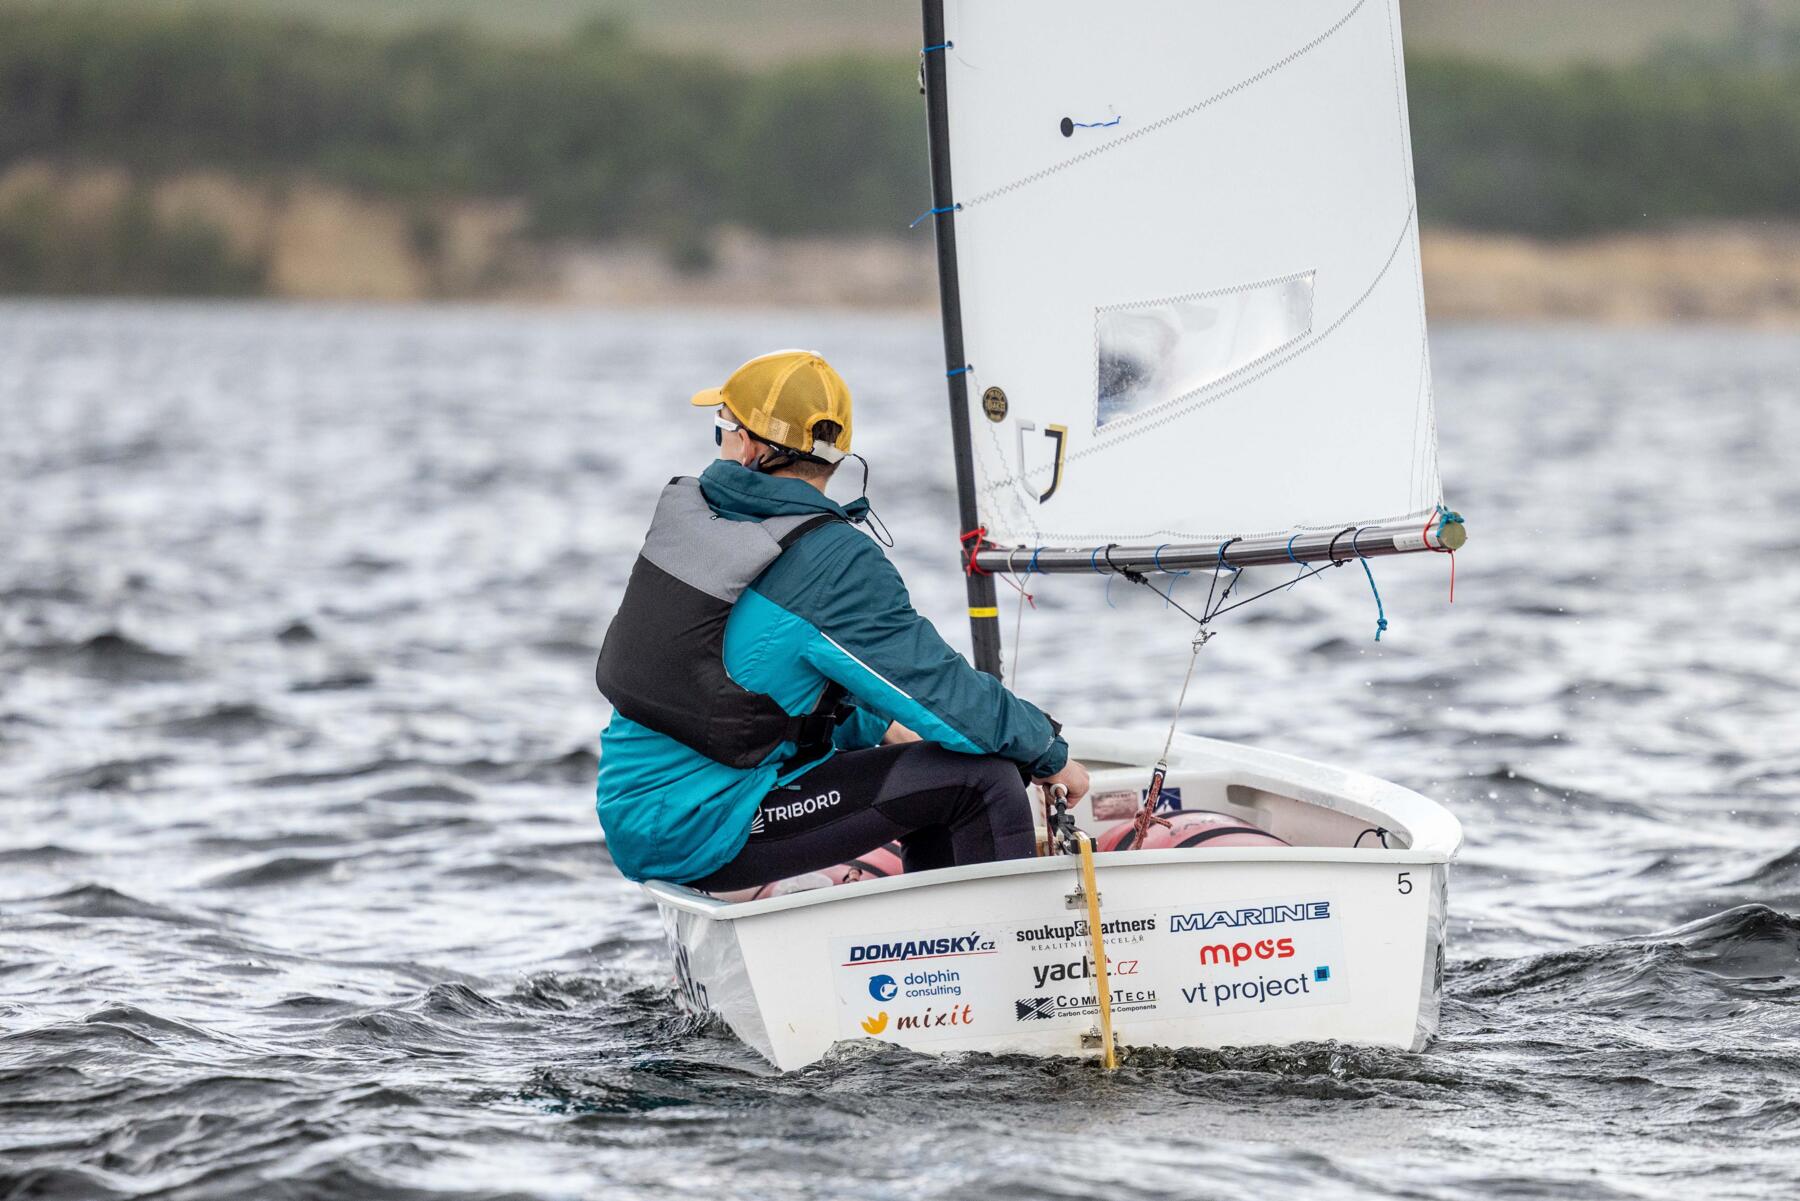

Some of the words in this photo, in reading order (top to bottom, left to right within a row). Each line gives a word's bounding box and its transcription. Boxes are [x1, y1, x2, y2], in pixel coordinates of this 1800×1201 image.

[764, 790, 841, 822] TRIBORD
[1397, 872, 1413, 895] 5
[1170, 901, 1331, 933] MARINE
[1016, 918, 1157, 942] soukup&artners
[904, 969, 960, 986] dolphin
[905, 984, 962, 998] consulting
[1181, 982, 1208, 1004] vt
[1214, 973, 1310, 1007] project
[897, 1004, 976, 1031] mixit
[1057, 1009, 1081, 1018] Carbon
